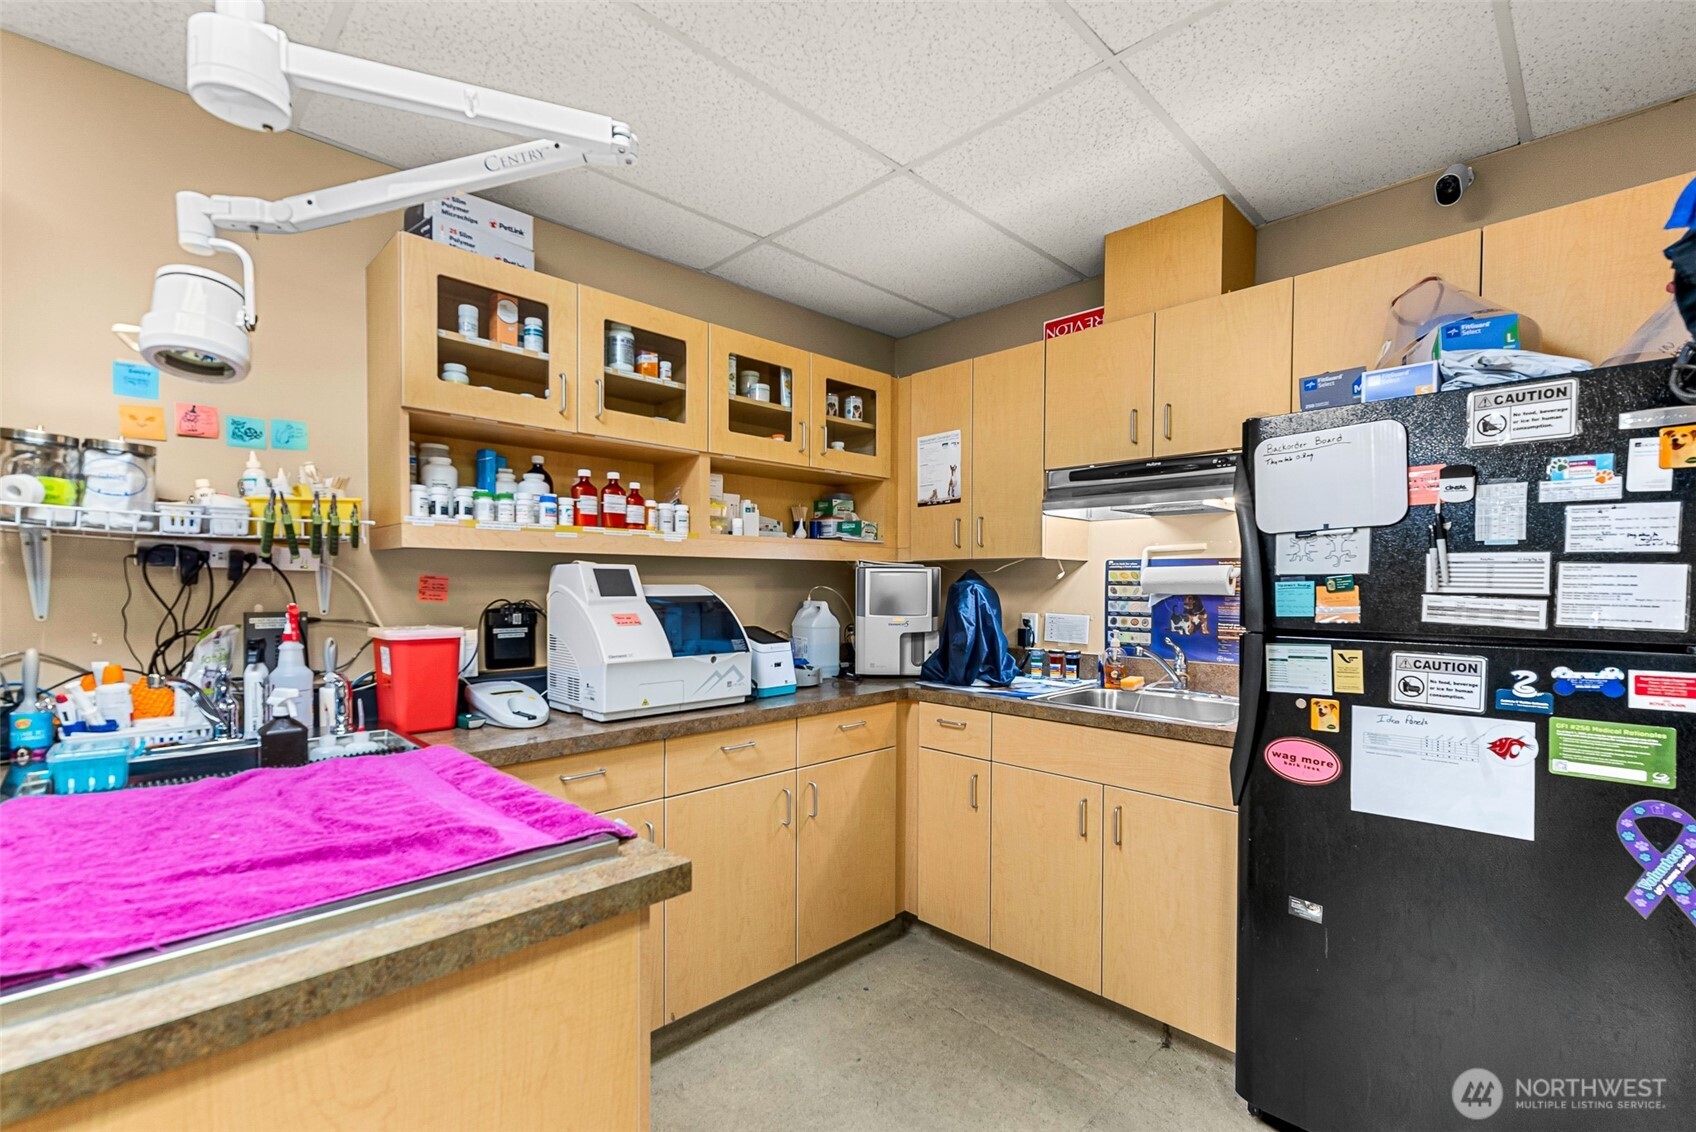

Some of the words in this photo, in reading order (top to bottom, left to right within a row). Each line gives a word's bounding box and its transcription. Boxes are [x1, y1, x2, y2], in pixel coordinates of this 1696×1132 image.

[441, 201, 470, 214] Polymer
[441, 208, 479, 225] Microchips
[459, 231, 473, 240] Slim
[498, 222, 526, 237] PetLink
[449, 235, 476, 249] Polymer
[1046, 315, 1104, 339] REVLON
[1461, 321, 1491, 331] FitGuard
[1461, 327, 1482, 336] Select
[1506, 332, 1516, 343] L
[1317, 373, 1344, 383] FitGuard
[1318, 380, 1336, 389] Select
[1493, 386, 1568, 406] CAUTION
[1523, 410, 1539, 418] food,
[1539, 407, 1569, 416] beverage
[1513, 424, 1553, 432] consumption.
[1266, 441, 1307, 454] Backorder
[1315, 434, 1343, 446] Board
[1413, 659, 1479, 674] CAUTION
[1429, 692, 1466, 700] consumption.
[1376, 713, 1400, 724] Idea
[1555, 722, 1569, 730] GFI
[1592, 725, 1622, 735] Medical
[1623, 729, 1668, 740] Rationales
[1271, 750, 1297, 763] wag
[1301, 756, 1334, 769] more
[1283, 760, 1301, 769] bark
[1636, 843, 1686, 891] Volunteer
